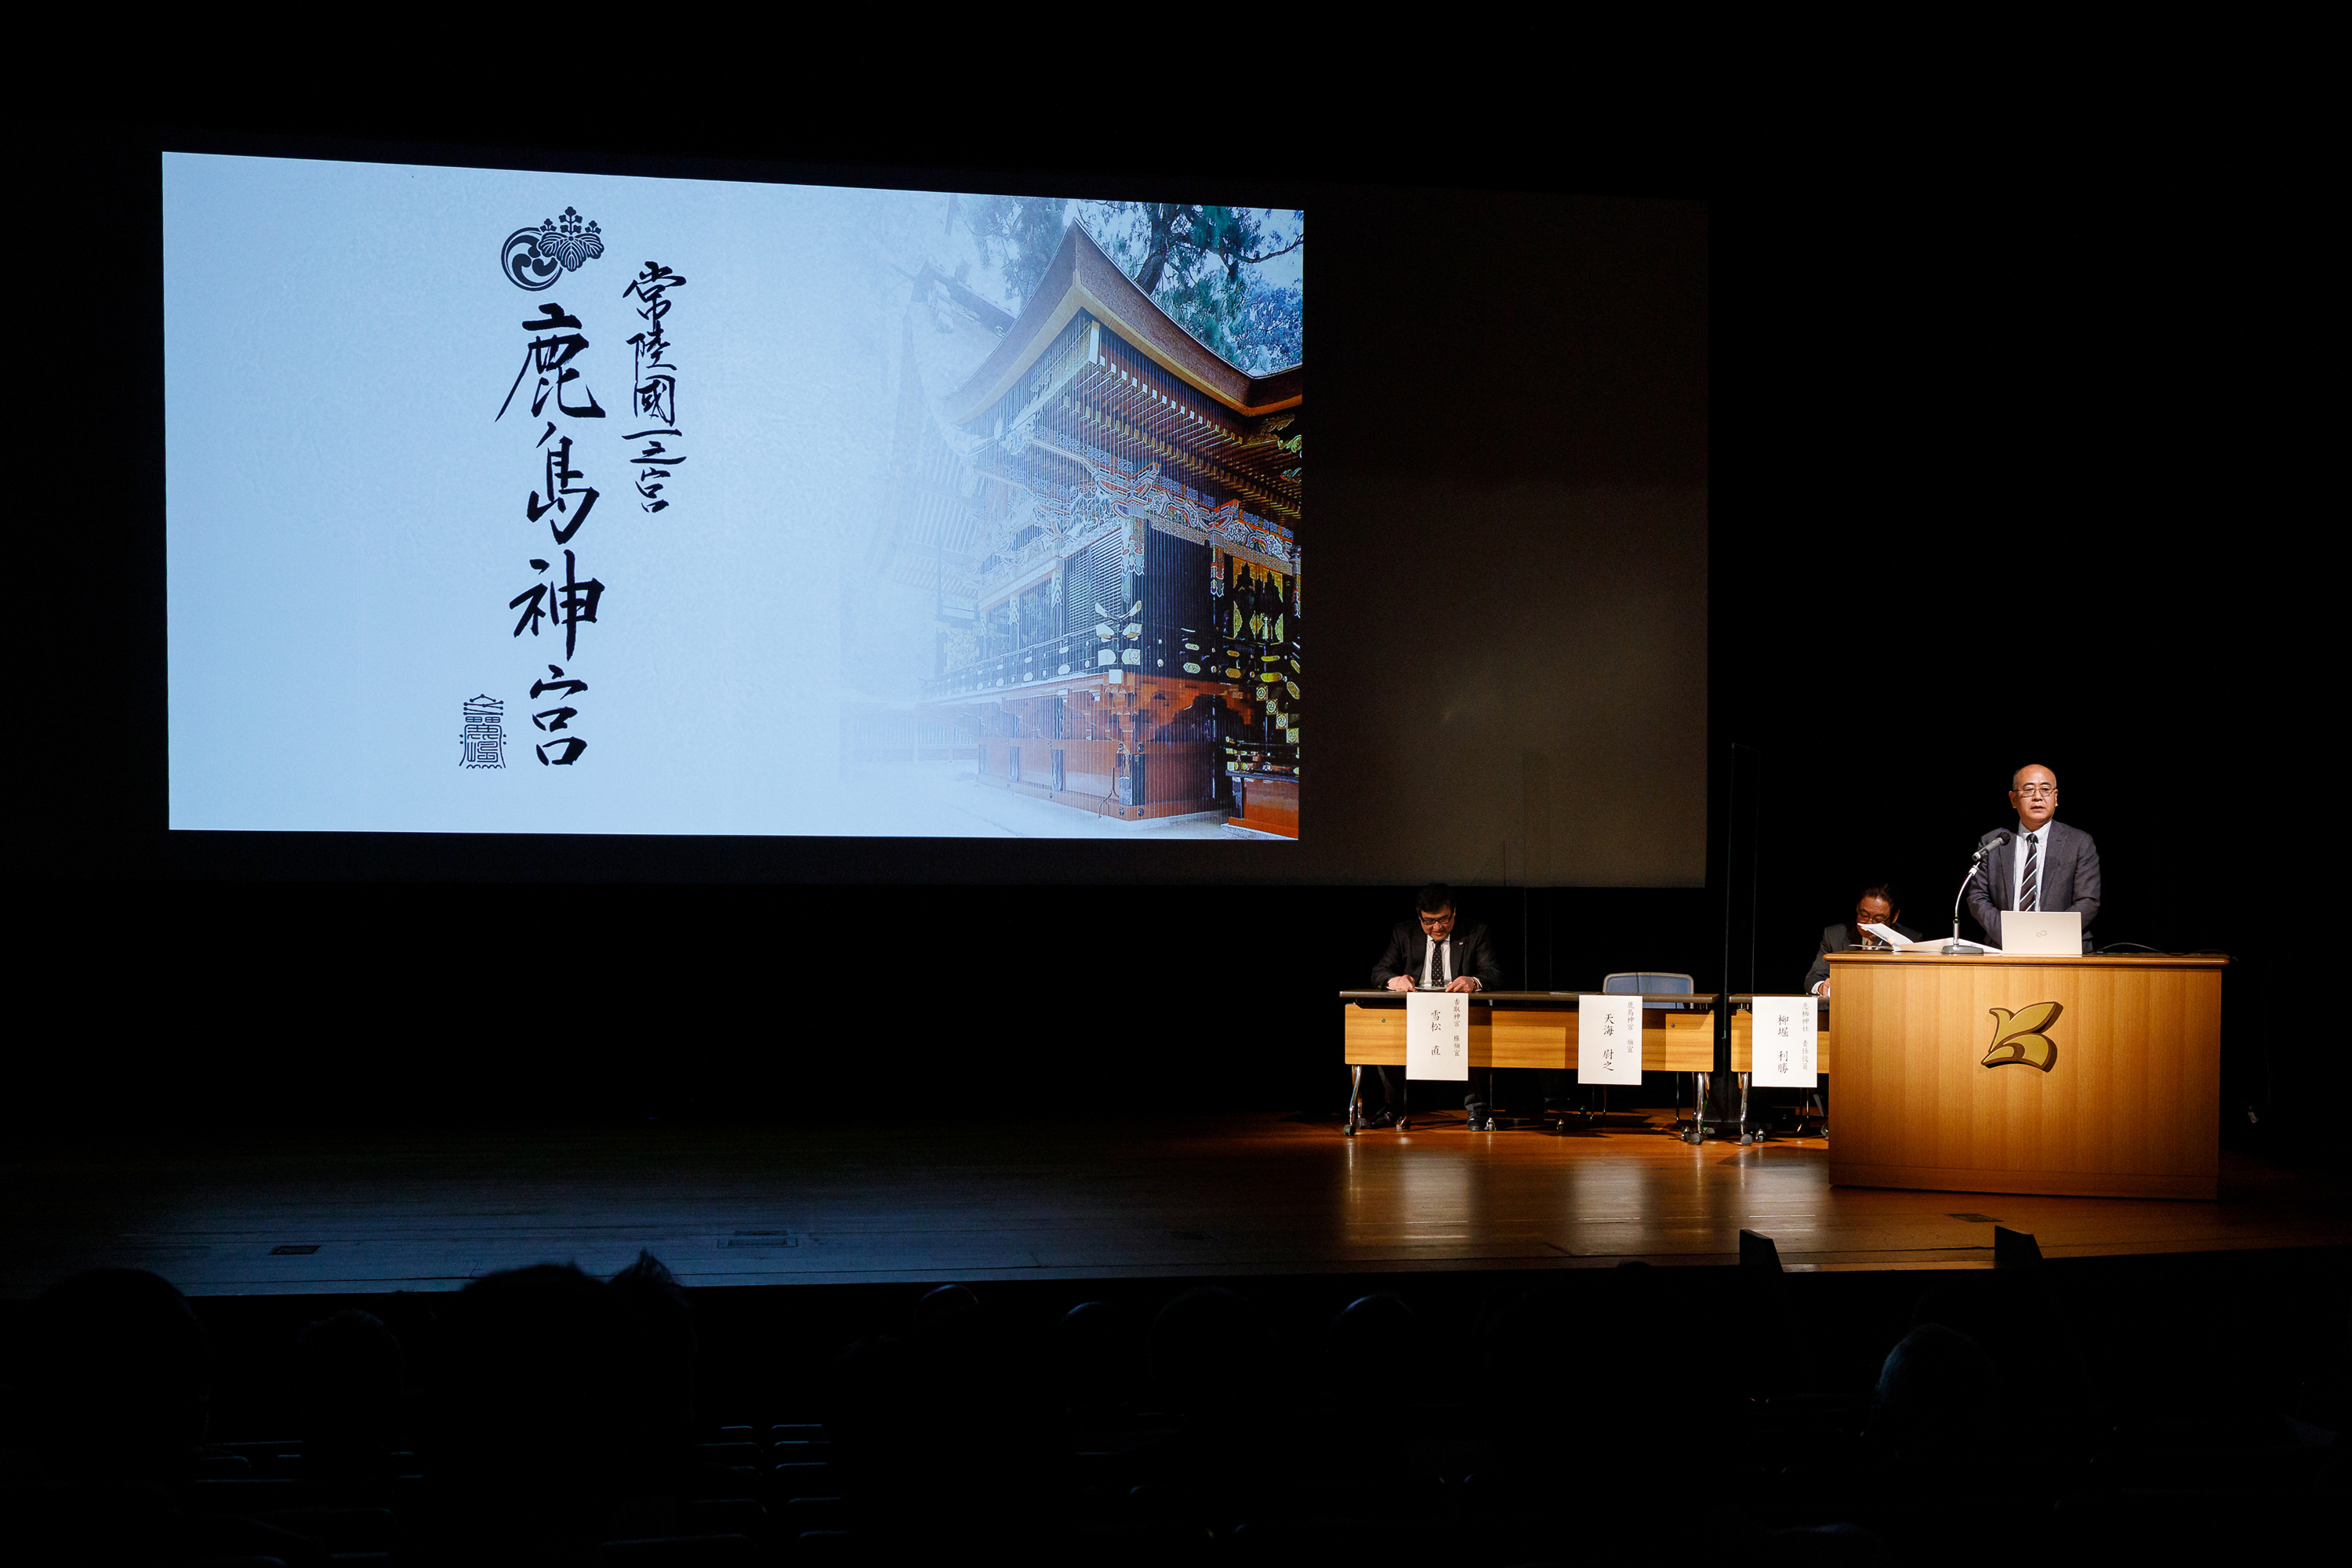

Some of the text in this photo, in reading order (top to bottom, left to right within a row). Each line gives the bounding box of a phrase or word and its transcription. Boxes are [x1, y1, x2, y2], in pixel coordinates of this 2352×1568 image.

[495, 302, 607, 767] 鹿島神宮
[1430, 1009, 1442, 1056] 雪松 直
[1453, 998, 1461, 1027] 香取神宮
[1603, 1013, 1615, 1036] 天海
[1777, 1014, 1789, 1074] 柳堀 利勝
